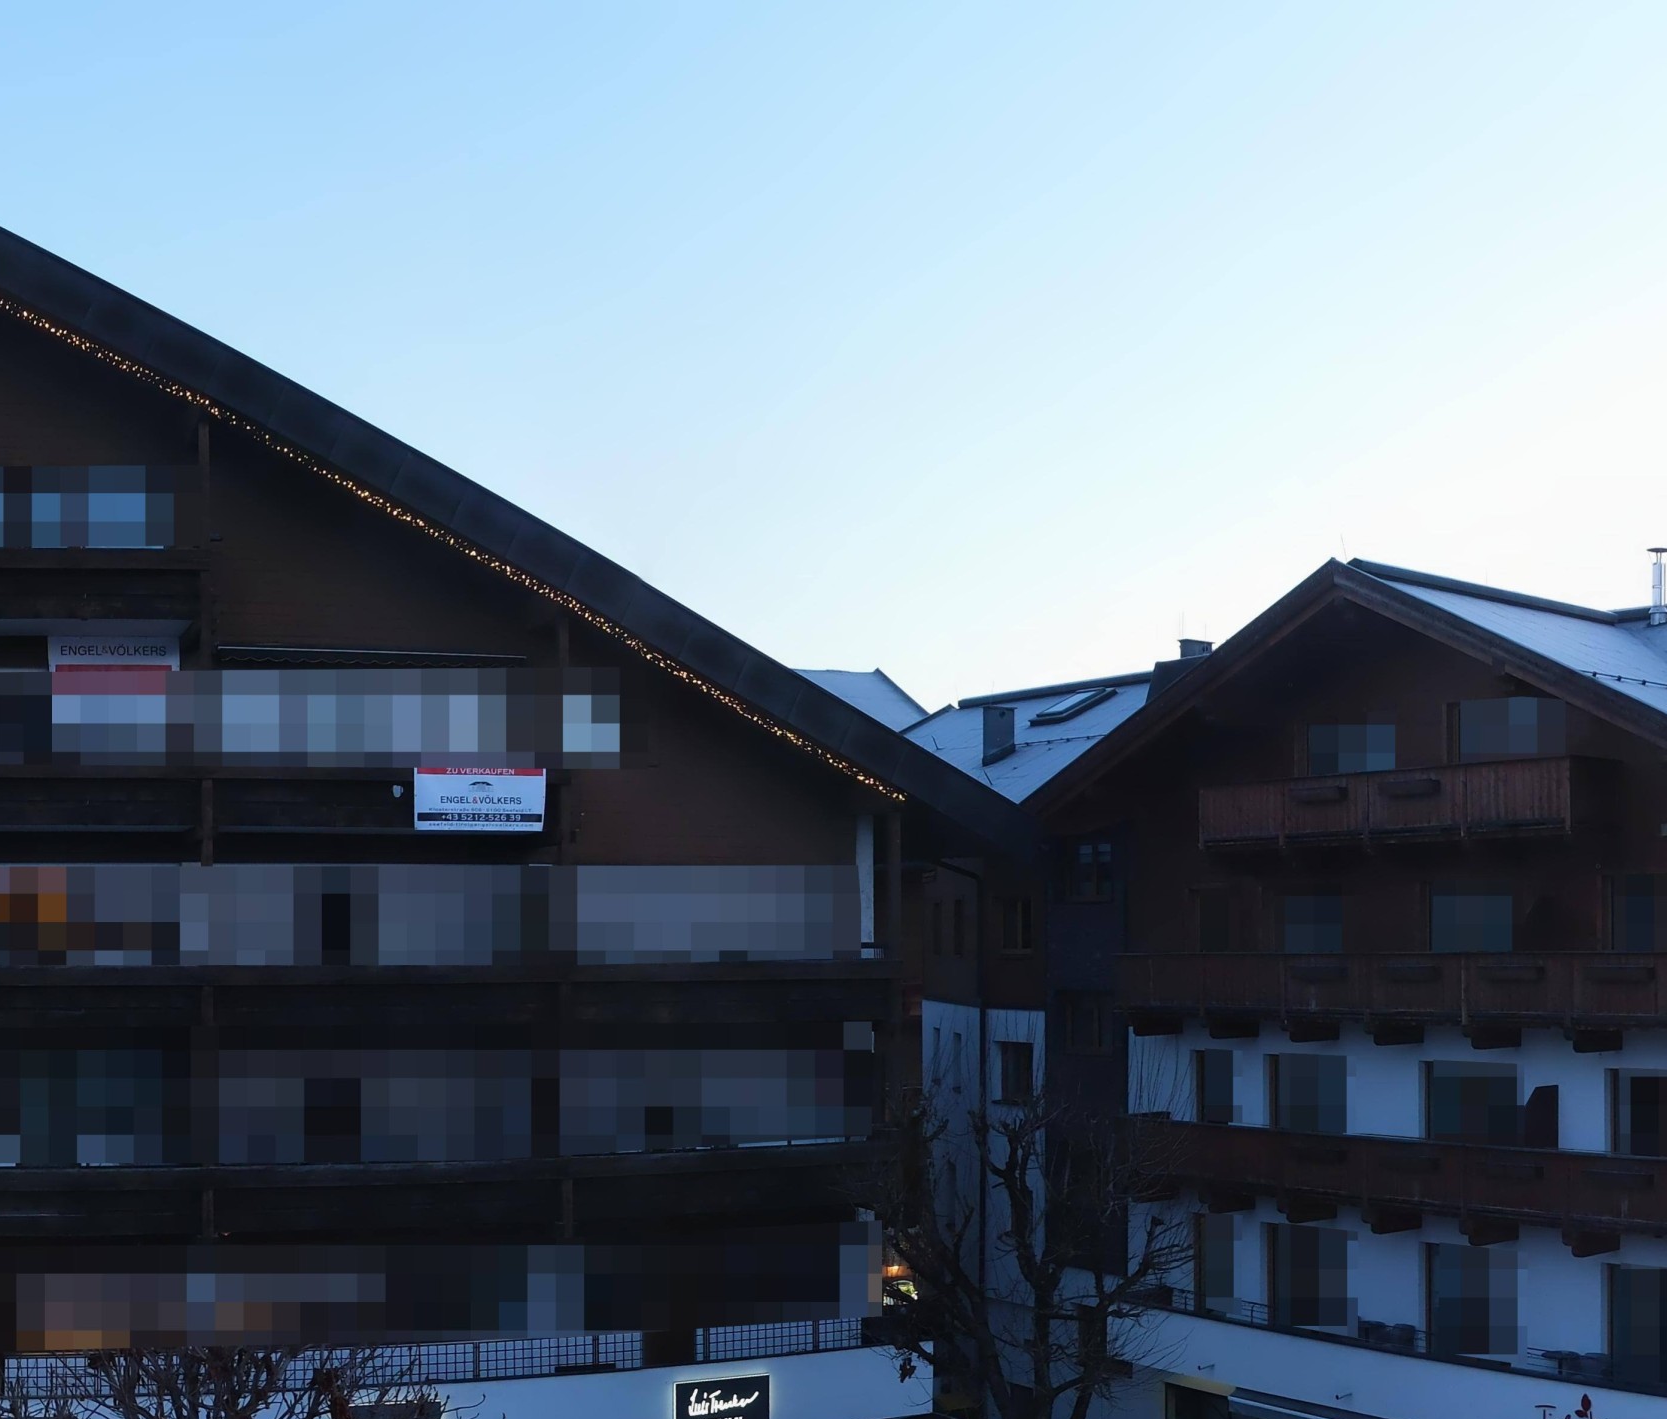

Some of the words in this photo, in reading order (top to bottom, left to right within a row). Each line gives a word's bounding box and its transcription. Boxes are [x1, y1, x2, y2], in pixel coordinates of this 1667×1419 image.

[446, 767, 458, 775] ZU
[459, 767, 515, 776] VERKAUFEN
[440, 795, 522, 805] ENGEL&VÖLKERS
